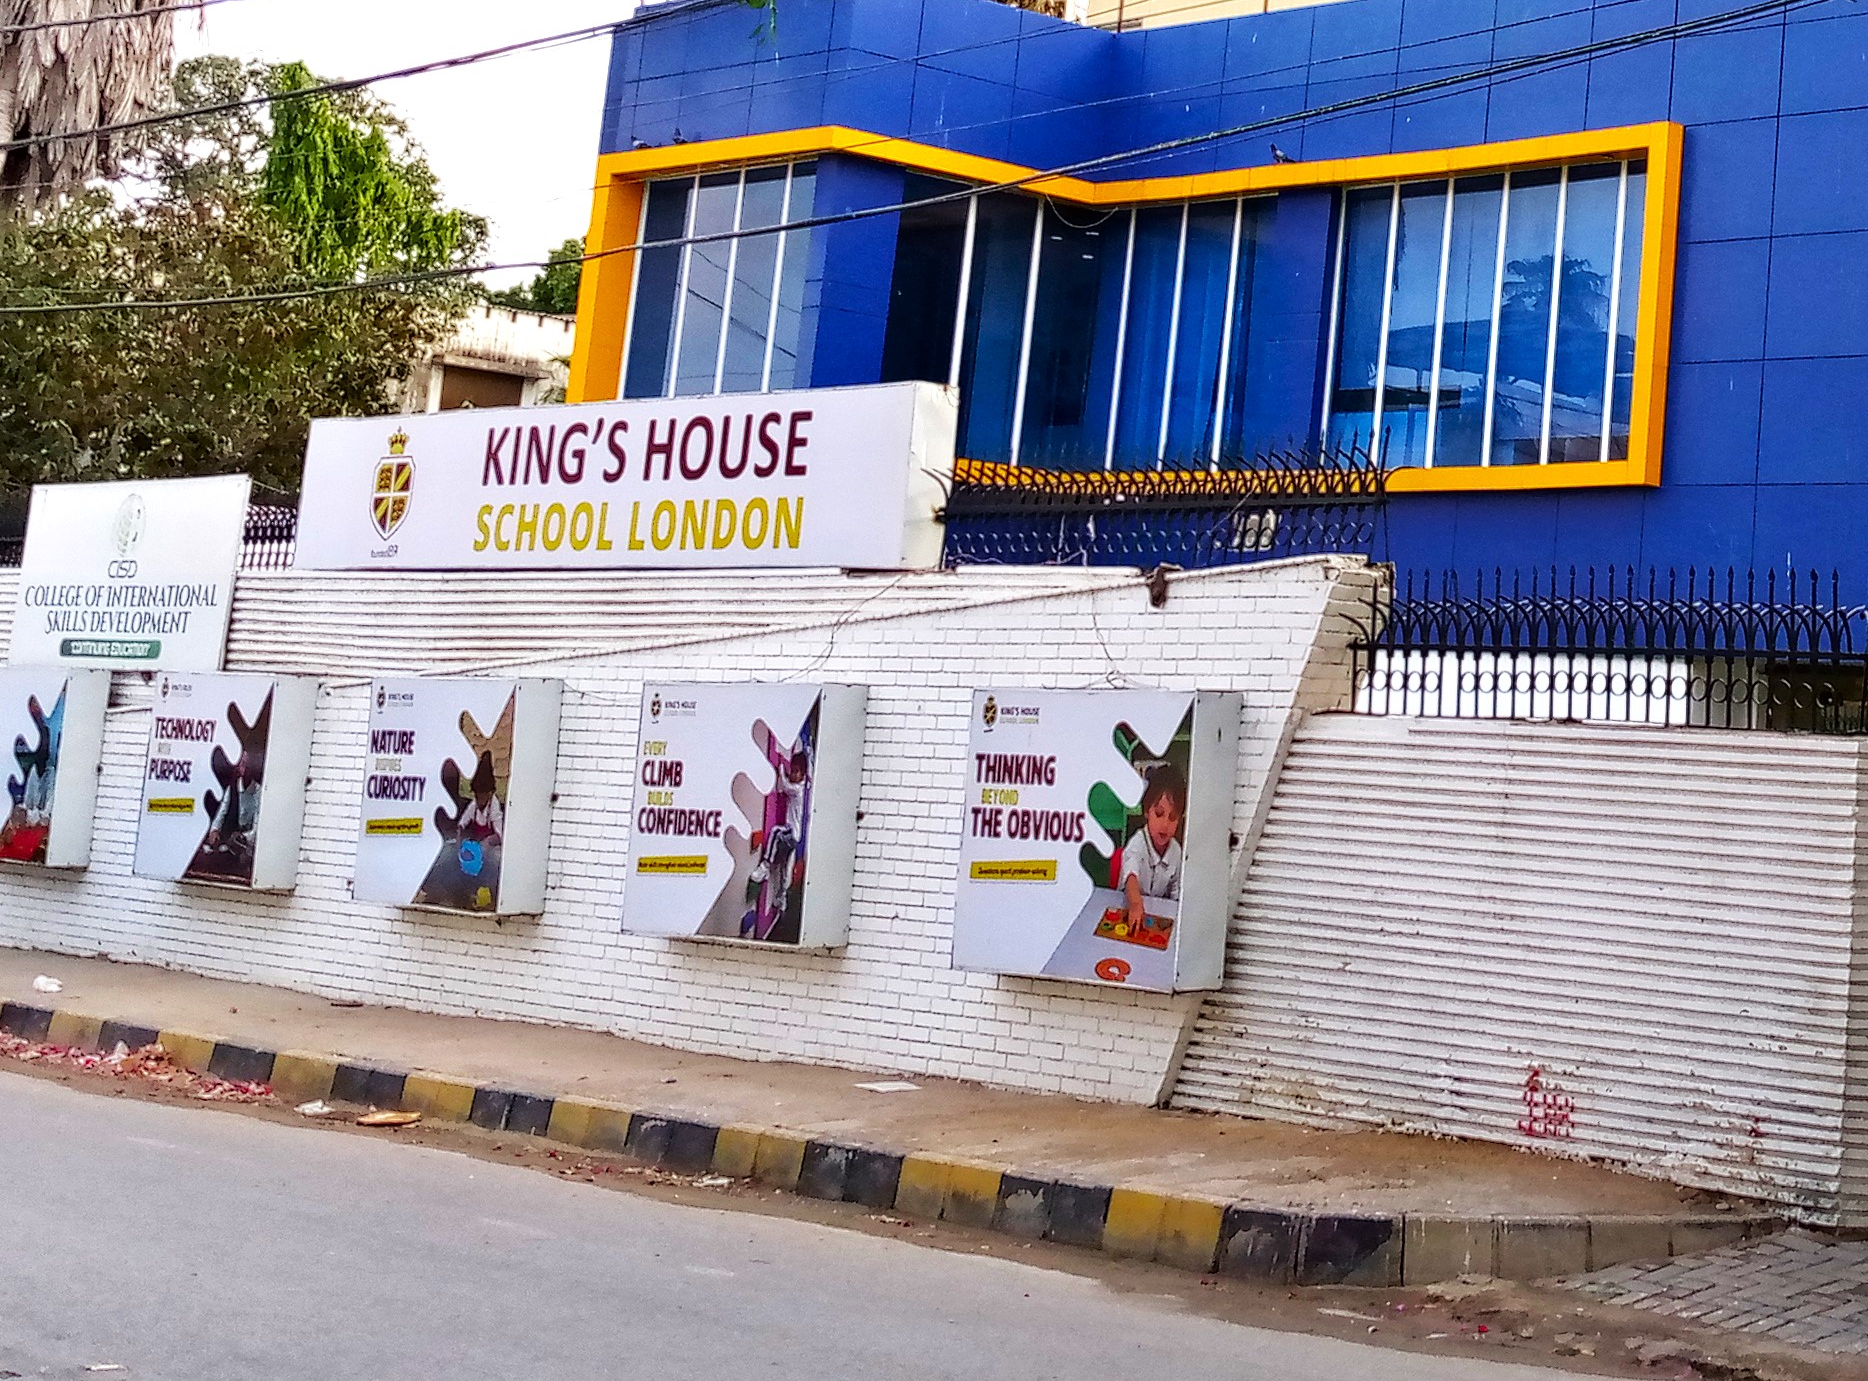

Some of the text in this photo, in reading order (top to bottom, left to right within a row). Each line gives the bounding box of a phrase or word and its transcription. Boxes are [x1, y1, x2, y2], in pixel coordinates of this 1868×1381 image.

[482, 411, 813, 487] KING'S HOUSE
[473, 497, 804, 552] SCHOOL LONDON
[25, 584, 217, 607] COLLEGE OF INTERNATIONAL
[45, 610, 191, 634] SKILLS DEVELOPMENT
[155, 716, 217, 742] TECHNOLOGY
[370, 729, 415, 755] NATURE
[148, 758, 192, 783] PURPOSE
[642, 759, 683, 787] CLIMB
[975, 753, 1056, 786] THINKING
[367, 774, 426, 802] CURIOSITY
[981, 788, 1019, 805] BEYOND
[638, 807, 722, 838] CONFIDENCE
[971, 807, 1085, 843] THE OBVIOUS
